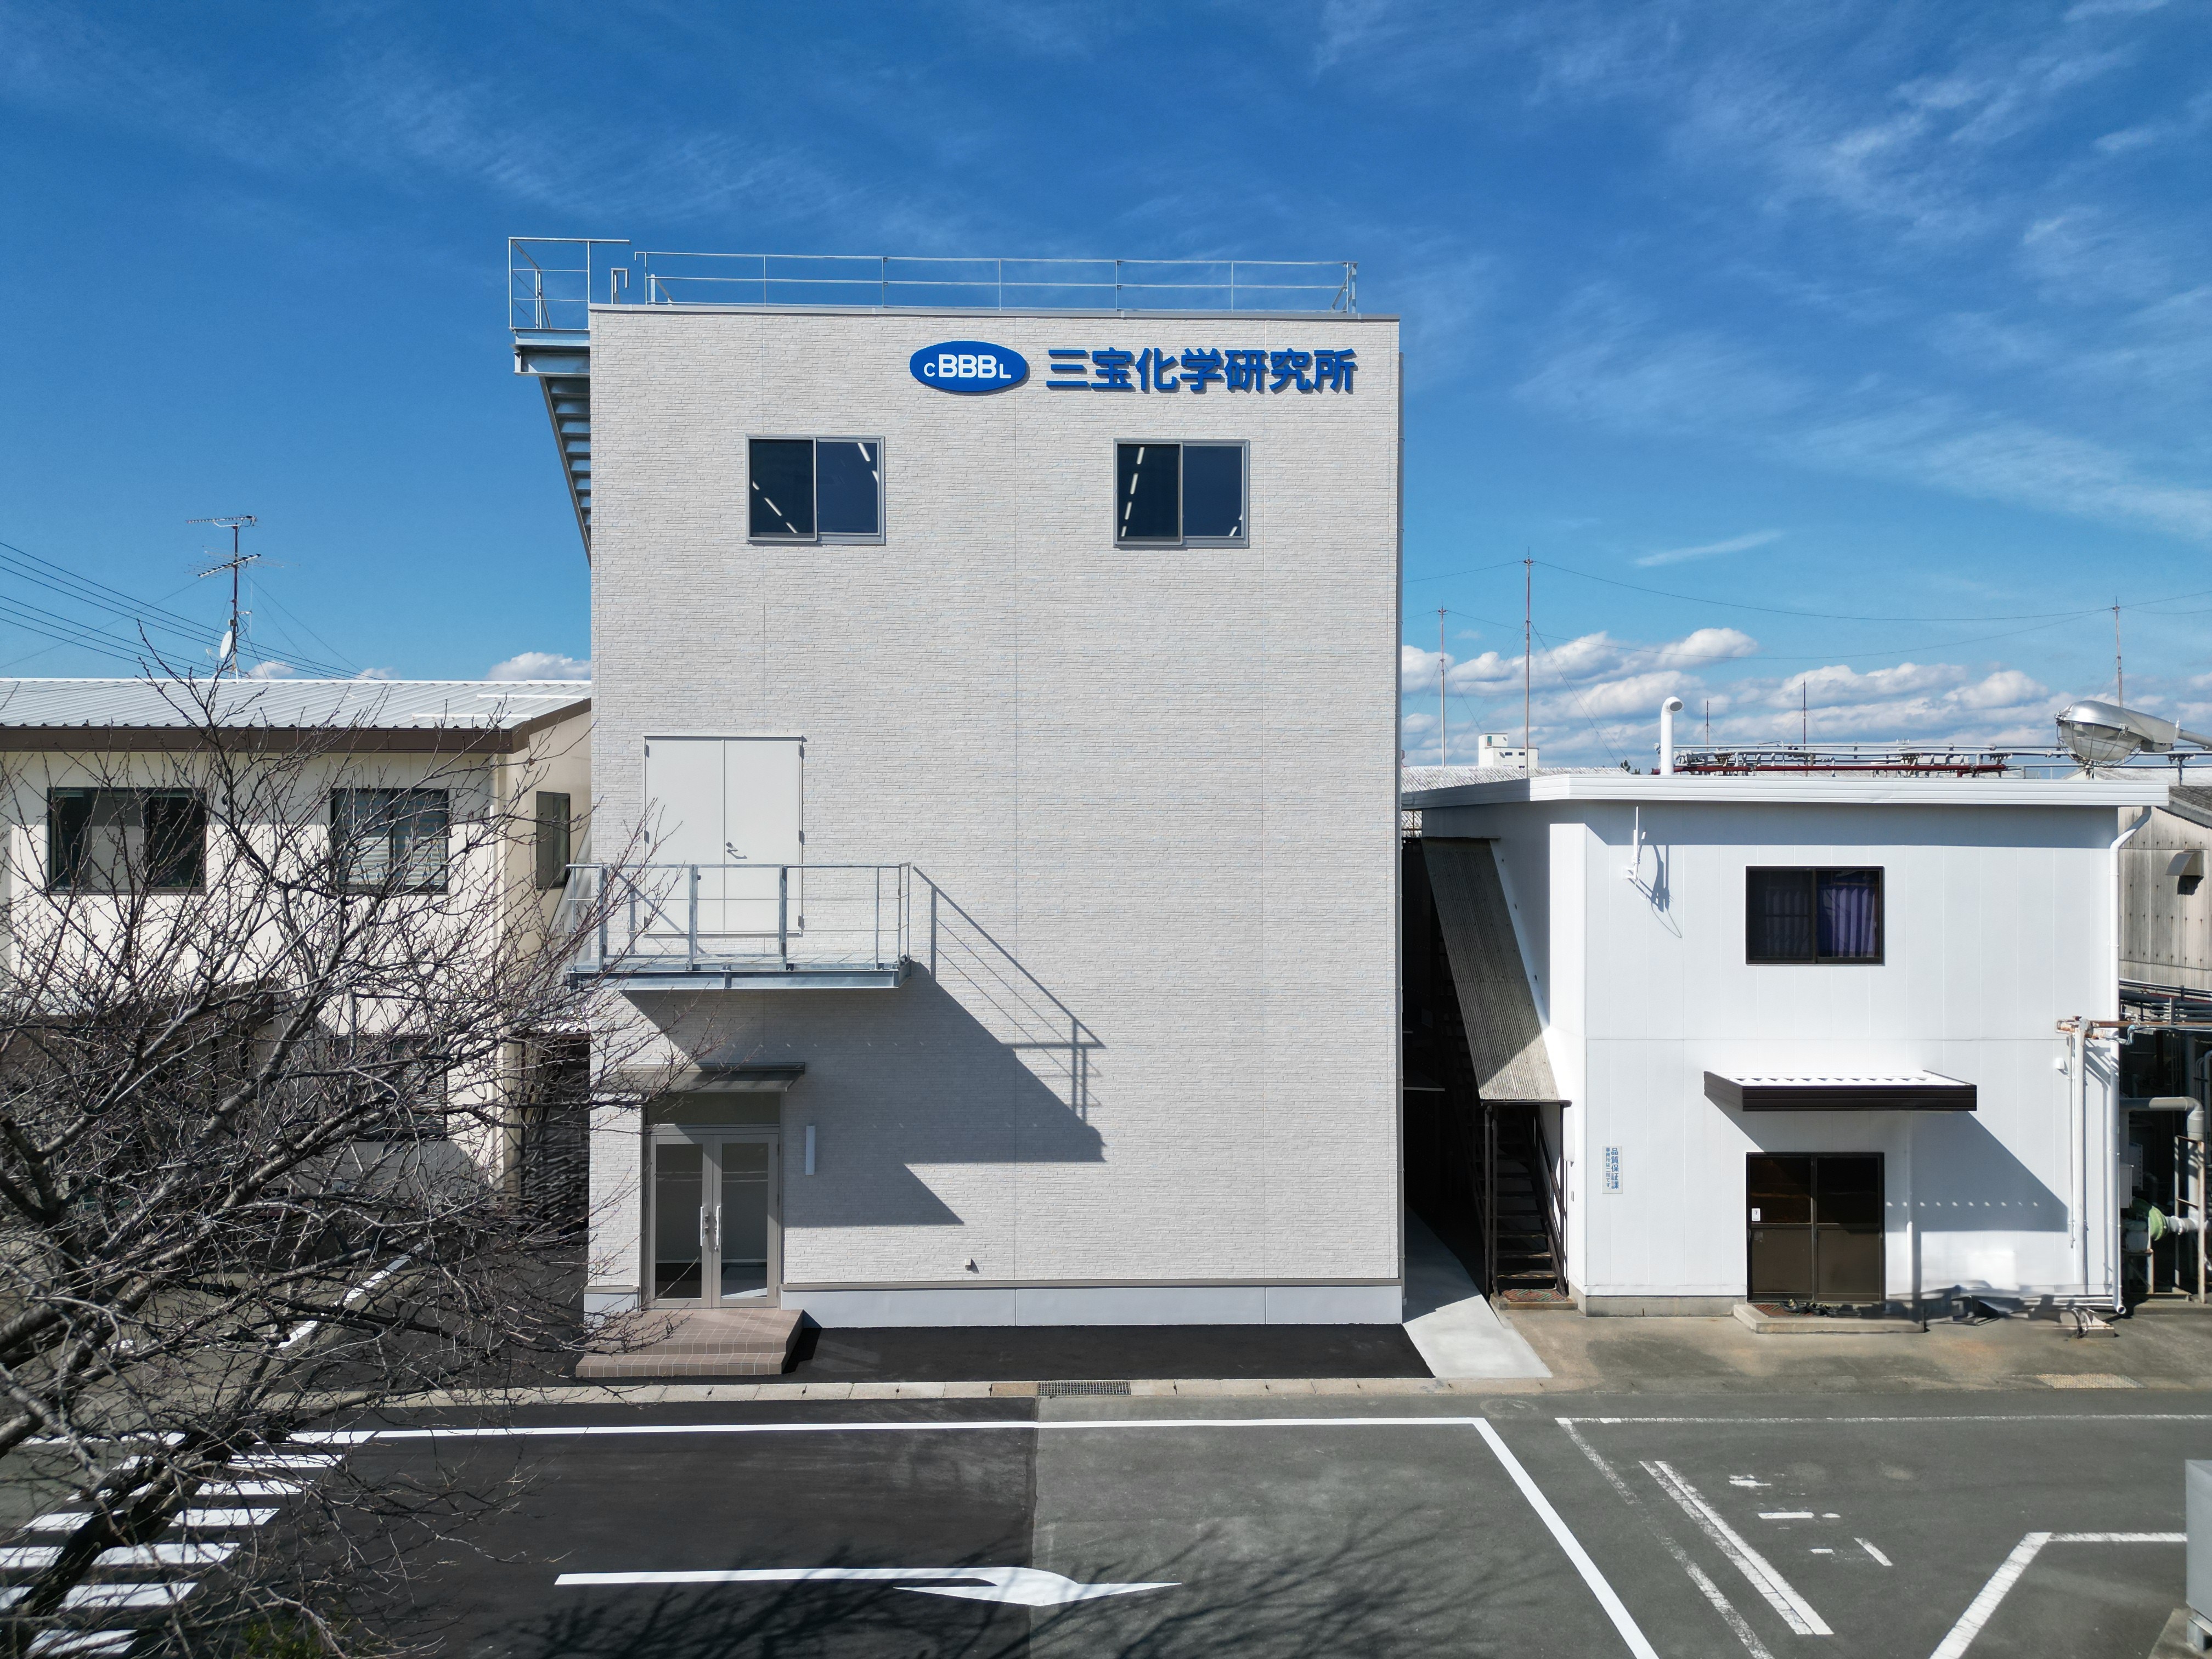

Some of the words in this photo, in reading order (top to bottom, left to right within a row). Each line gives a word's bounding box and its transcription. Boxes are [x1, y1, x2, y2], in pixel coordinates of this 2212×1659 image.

[1046, 347, 1355, 391] 三宝化学研究所
[1611, 1147, 1619, 1189] 品質保証課
